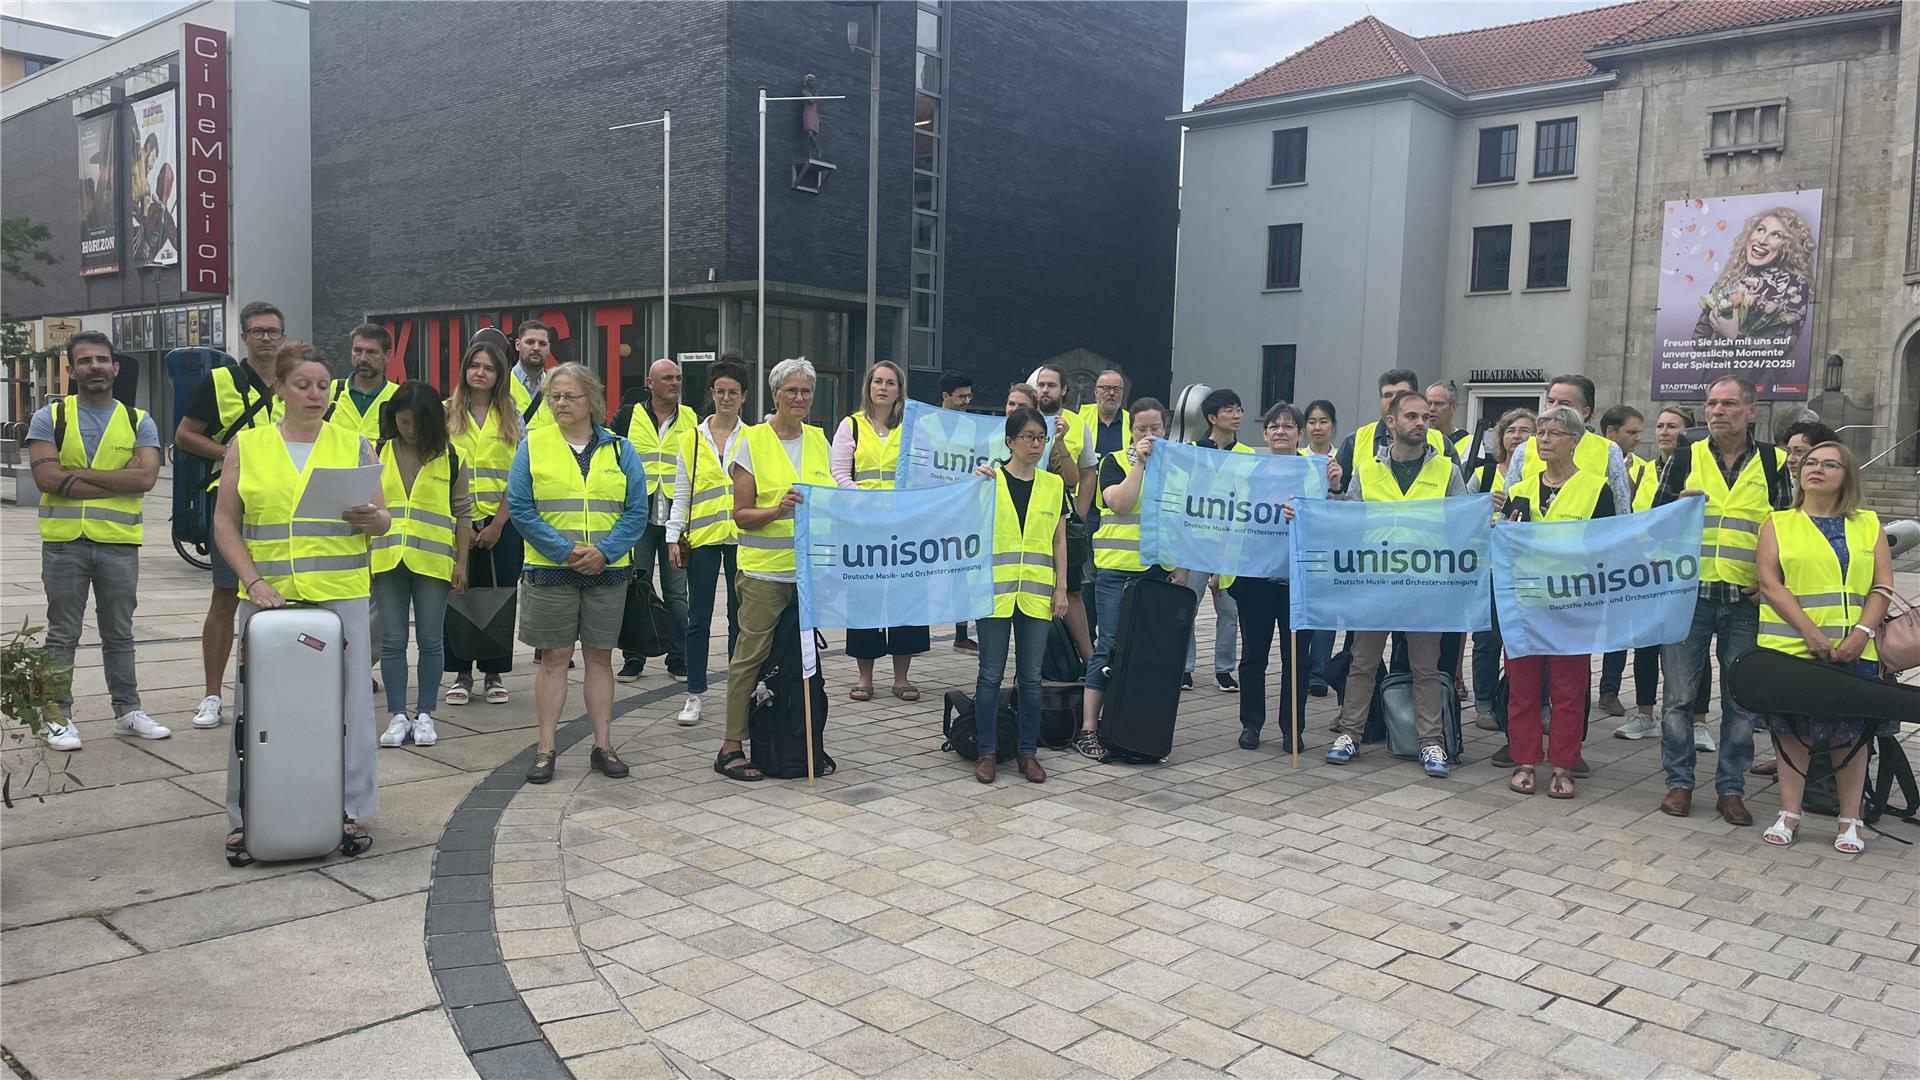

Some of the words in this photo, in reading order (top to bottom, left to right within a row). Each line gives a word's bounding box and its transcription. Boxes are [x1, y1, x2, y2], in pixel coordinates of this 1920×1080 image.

[192, 37, 222, 283] CineMotion
[1663, 339, 1696, 347] Freuen
[1698, 338, 1712, 347] Sie
[1714, 337, 1733, 346] sich
[1735, 337, 1751, 346] mit
[1773, 336, 1792, 345] auf
[1663, 349, 1734, 360] unvergessliche
[1736, 348, 1784, 357] Momente
[1470, 369, 1544, 380] THEATERKASSE
[1672, 360, 1688, 369] der
[1690, 360, 1732, 370] Spielzeit
[1733, 359, 1796, 369] 2024/2025!
[933, 448, 1002, 474] unis
[1185, 491, 1290, 525] unison
[1247, 527, 1290, 537] Orchestervere
[842, 533, 981, 567] unisono
[1333, 540, 1478, 574] unisono
[876, 571, 899, 579] Musik-
[901, 570, 914, 578] und
[915, 564, 982, 578] Orchestervereinigung
[1546, 554, 1698, 599] unisono
[1333, 578, 1364, 586] Deutsche
[1391, 578, 1404, 586] und
[1405, 578, 1479, 587] Orchestervereinigung
[1549, 602, 1582, 611] Deutsche
[1583, 599, 1609, 608] Musik-
[1610, 596, 1624, 604] und
[1625, 585, 1698, 602] Orchestervereinigung
